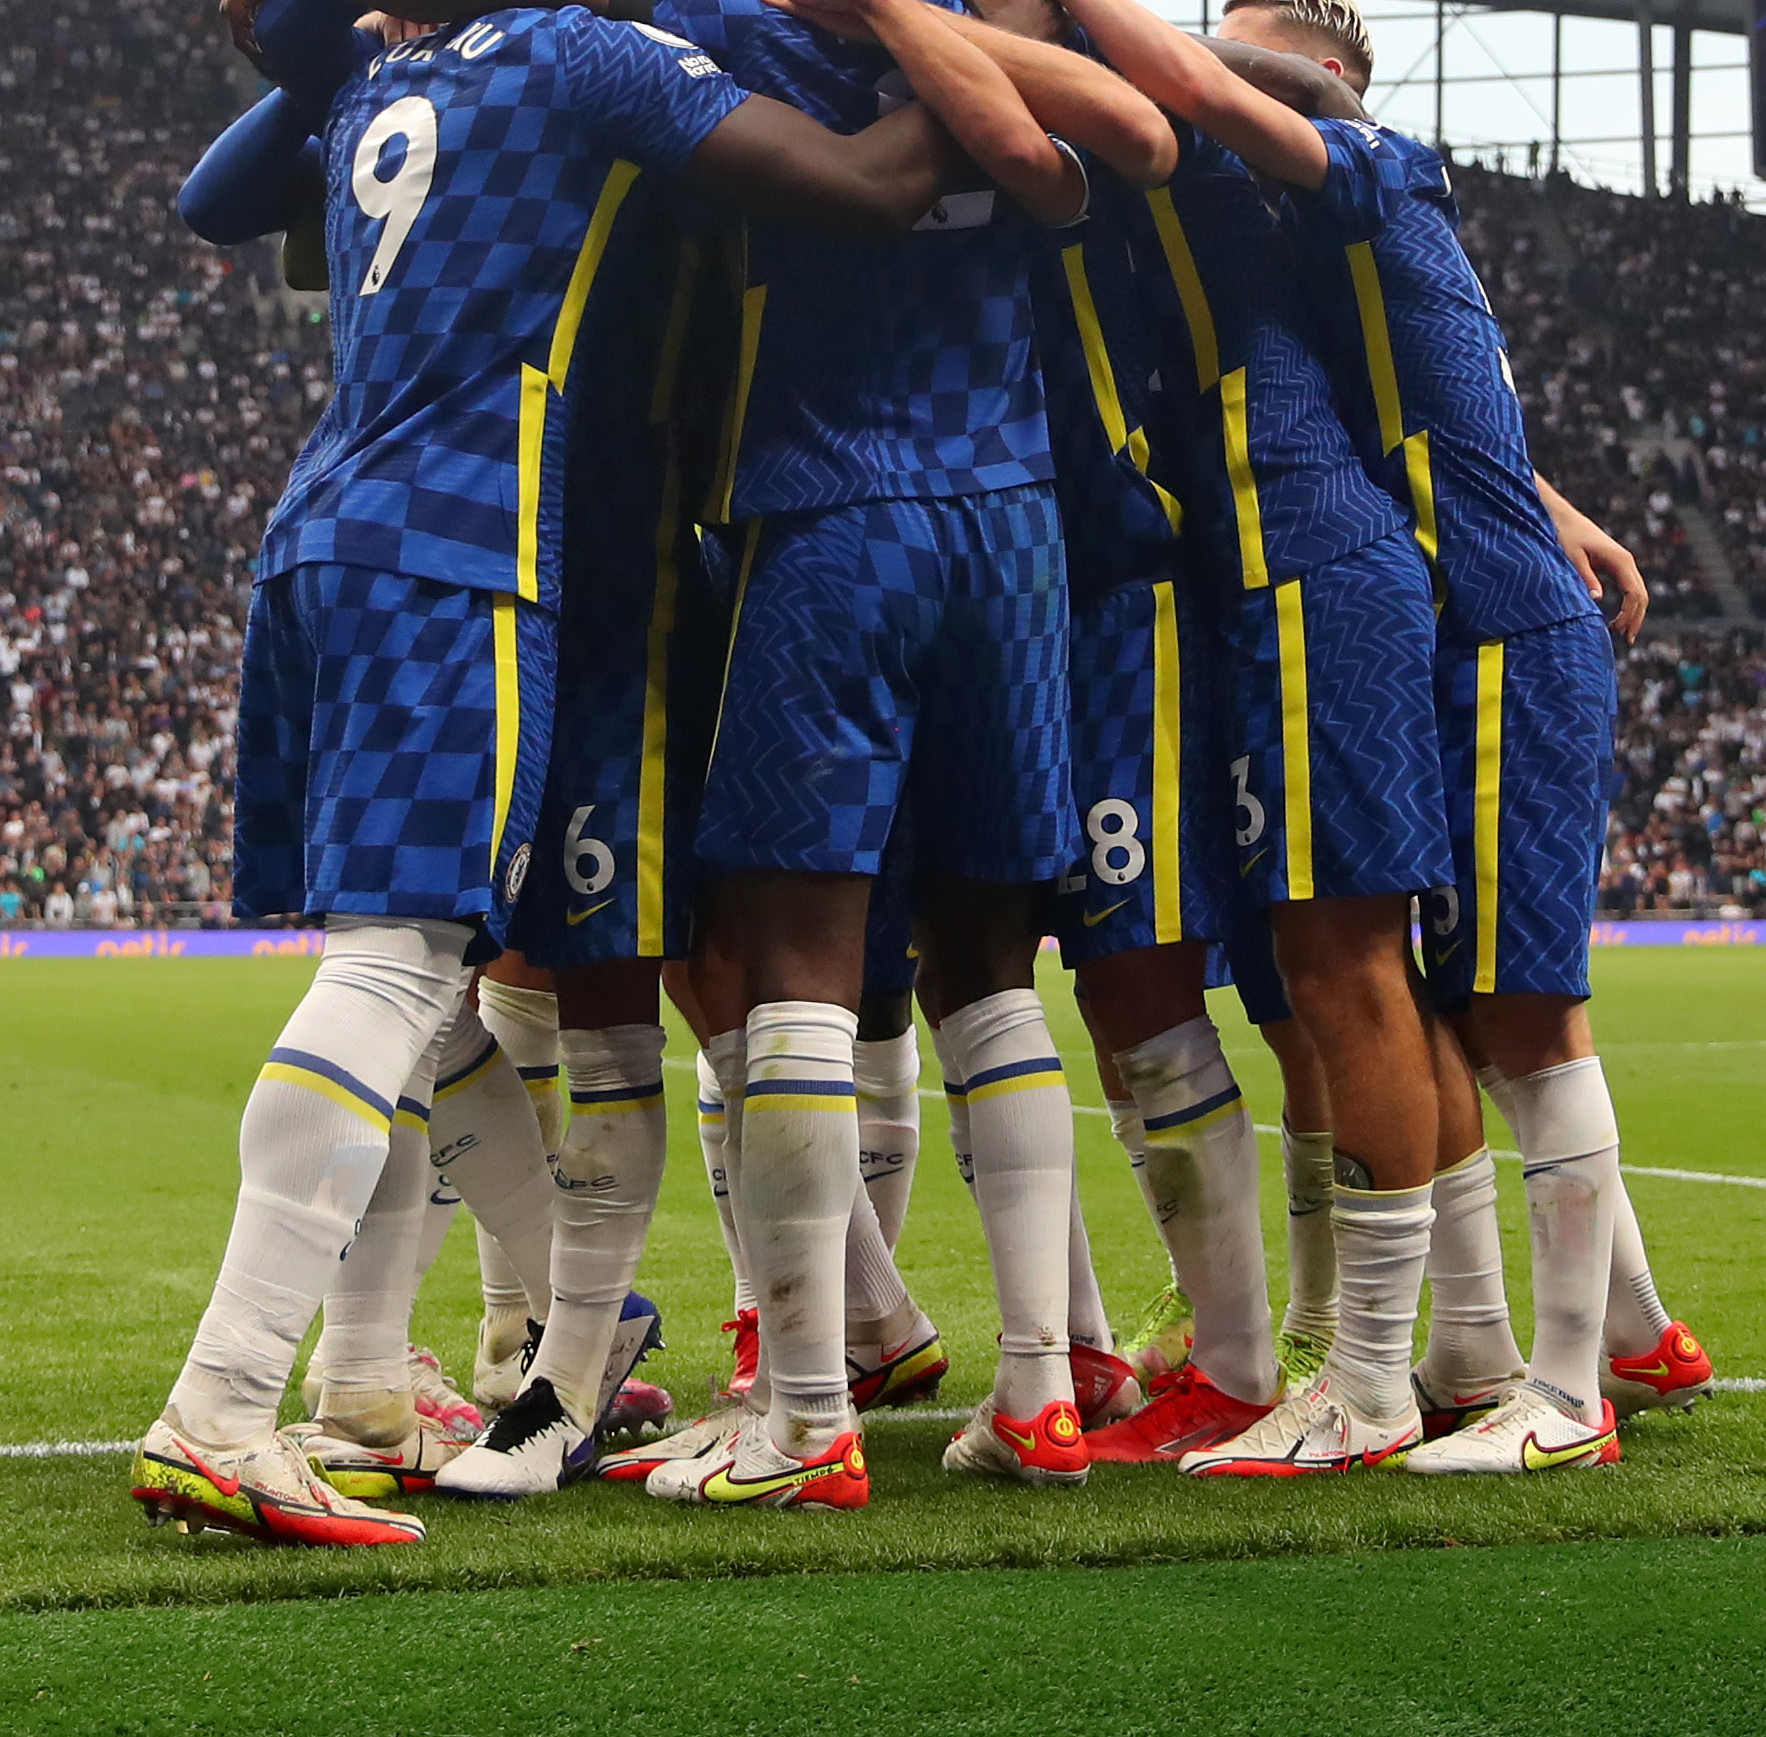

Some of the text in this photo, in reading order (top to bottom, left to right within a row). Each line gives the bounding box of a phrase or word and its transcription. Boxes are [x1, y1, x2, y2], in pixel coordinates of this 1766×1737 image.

[352, 96, 438, 295] 9
[563, 804, 616, 895] 6
[1590, 923, 1628, 944] tir
[252, 934, 324, 957] eti
[860, 1150, 905, 1166] CFC
[956, 1153, 974, 1167] CF
